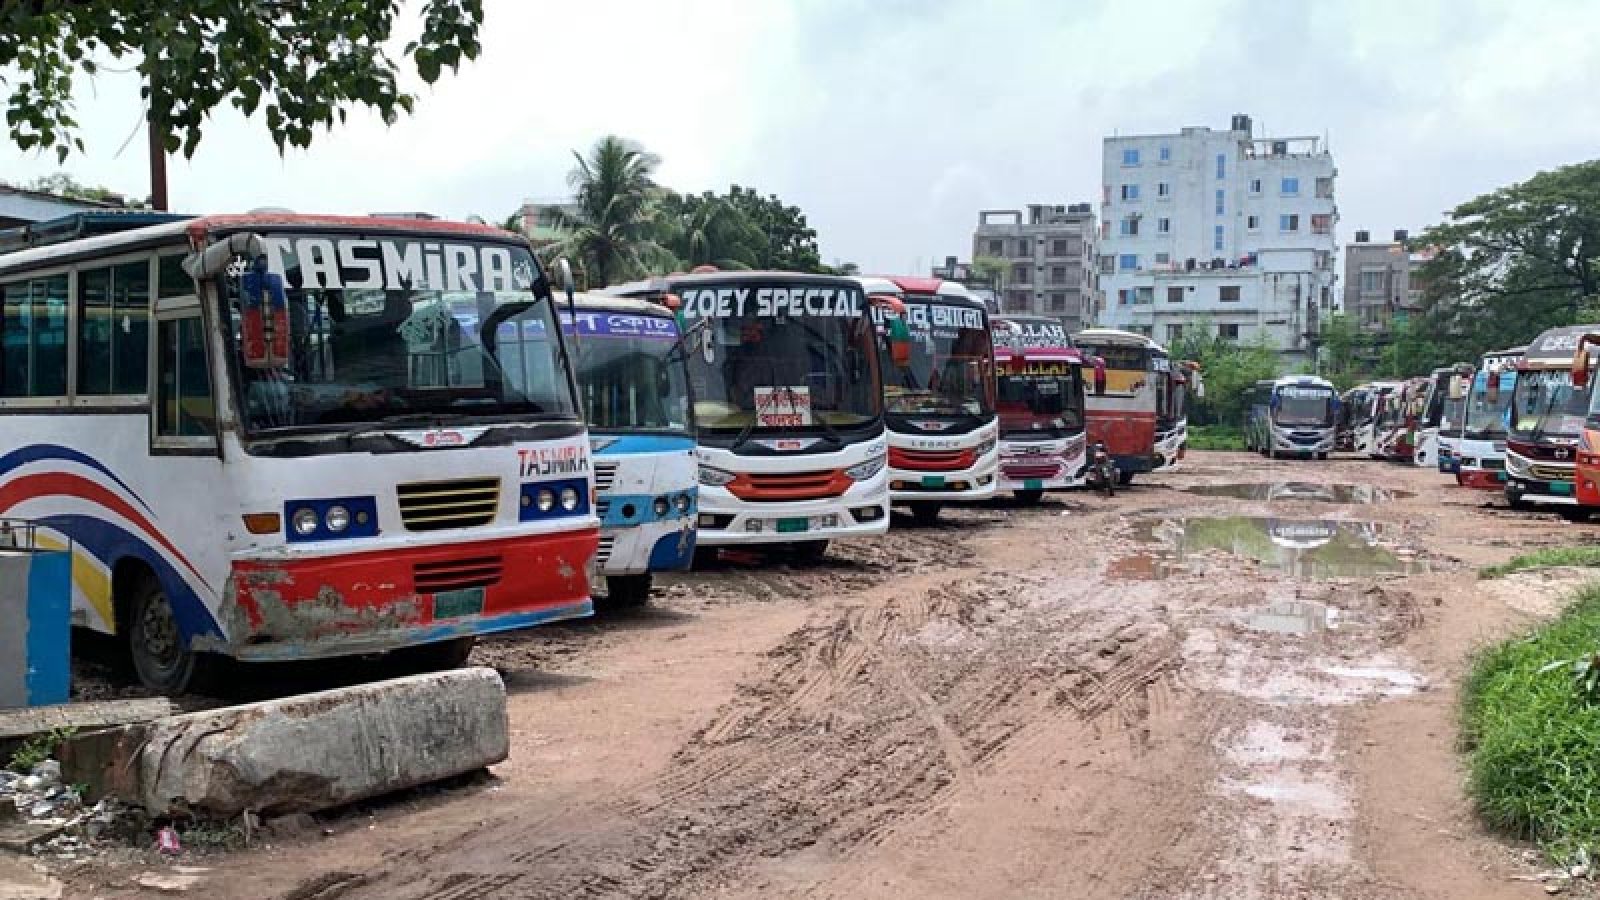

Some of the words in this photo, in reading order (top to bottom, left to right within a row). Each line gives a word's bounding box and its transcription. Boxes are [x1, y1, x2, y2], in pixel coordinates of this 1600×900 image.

[682, 288, 749, 318] ZOEY
[757, 288, 862, 317] SPECIAL
[517, 446, 589, 478] TASMIRA
